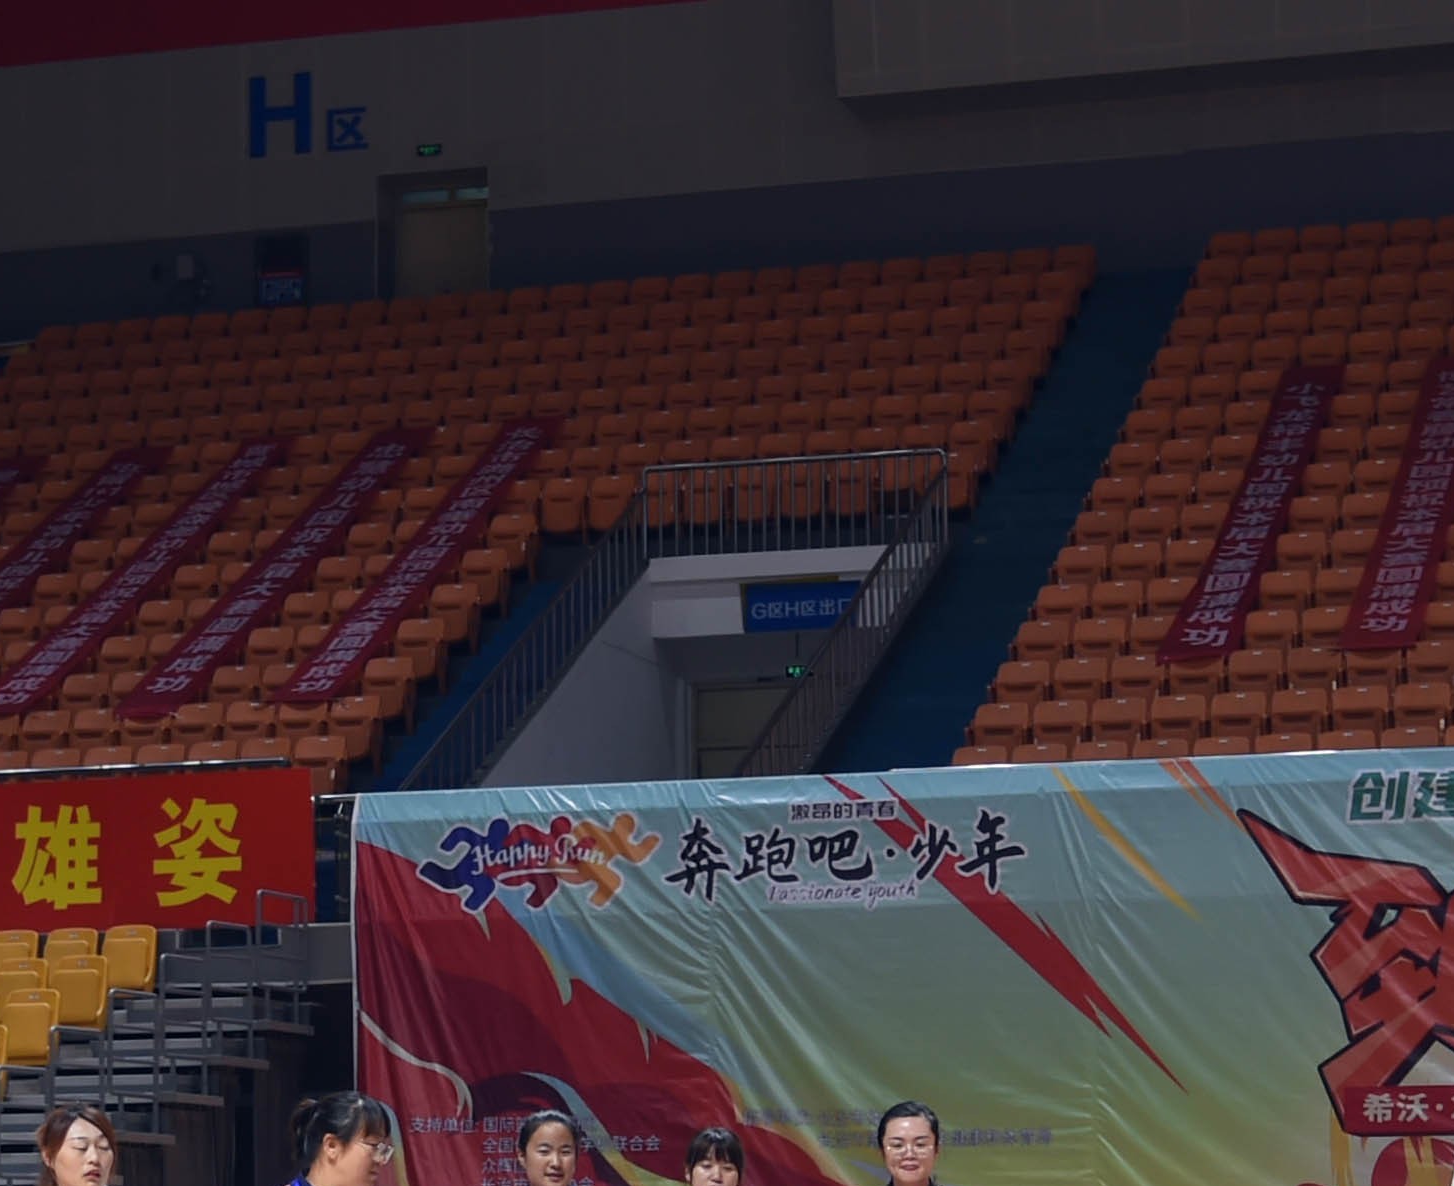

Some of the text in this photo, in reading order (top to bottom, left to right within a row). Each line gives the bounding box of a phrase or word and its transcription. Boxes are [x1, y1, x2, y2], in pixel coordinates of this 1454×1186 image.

[249, 72, 369, 158] H区
[791, 801, 896, 821] 激昂的青春
[471, 835, 607, 875] Happy Run
[866, 880, 918, 908] youth
